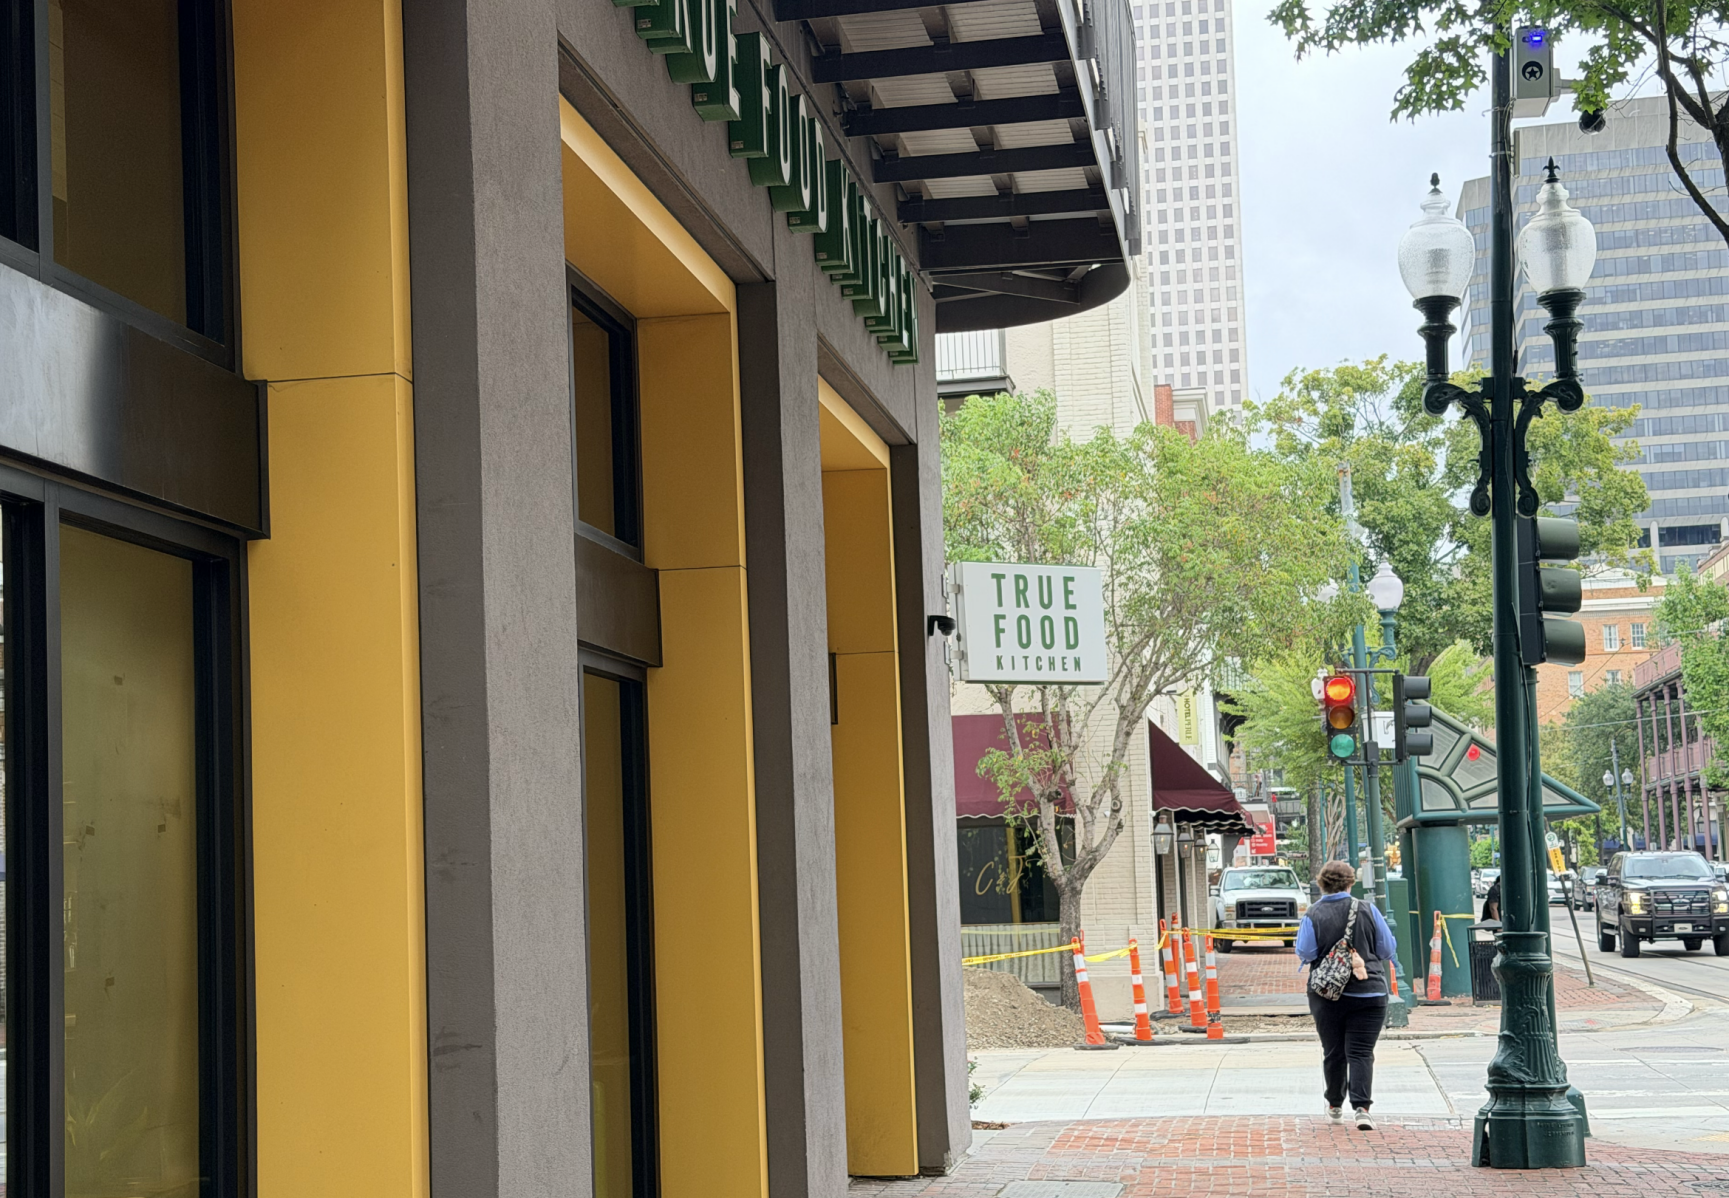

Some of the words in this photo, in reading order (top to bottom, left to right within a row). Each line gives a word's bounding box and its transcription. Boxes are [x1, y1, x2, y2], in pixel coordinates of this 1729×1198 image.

[652, 0, 742, 121] UE
[754, 31, 829, 234] FOOD
[836, 158, 919, 365] KITCHEN
[990, 573, 1077, 610] TRUE
[993, 614, 1079, 650] FOOD
[996, 655, 1081, 672] KITCHEN
